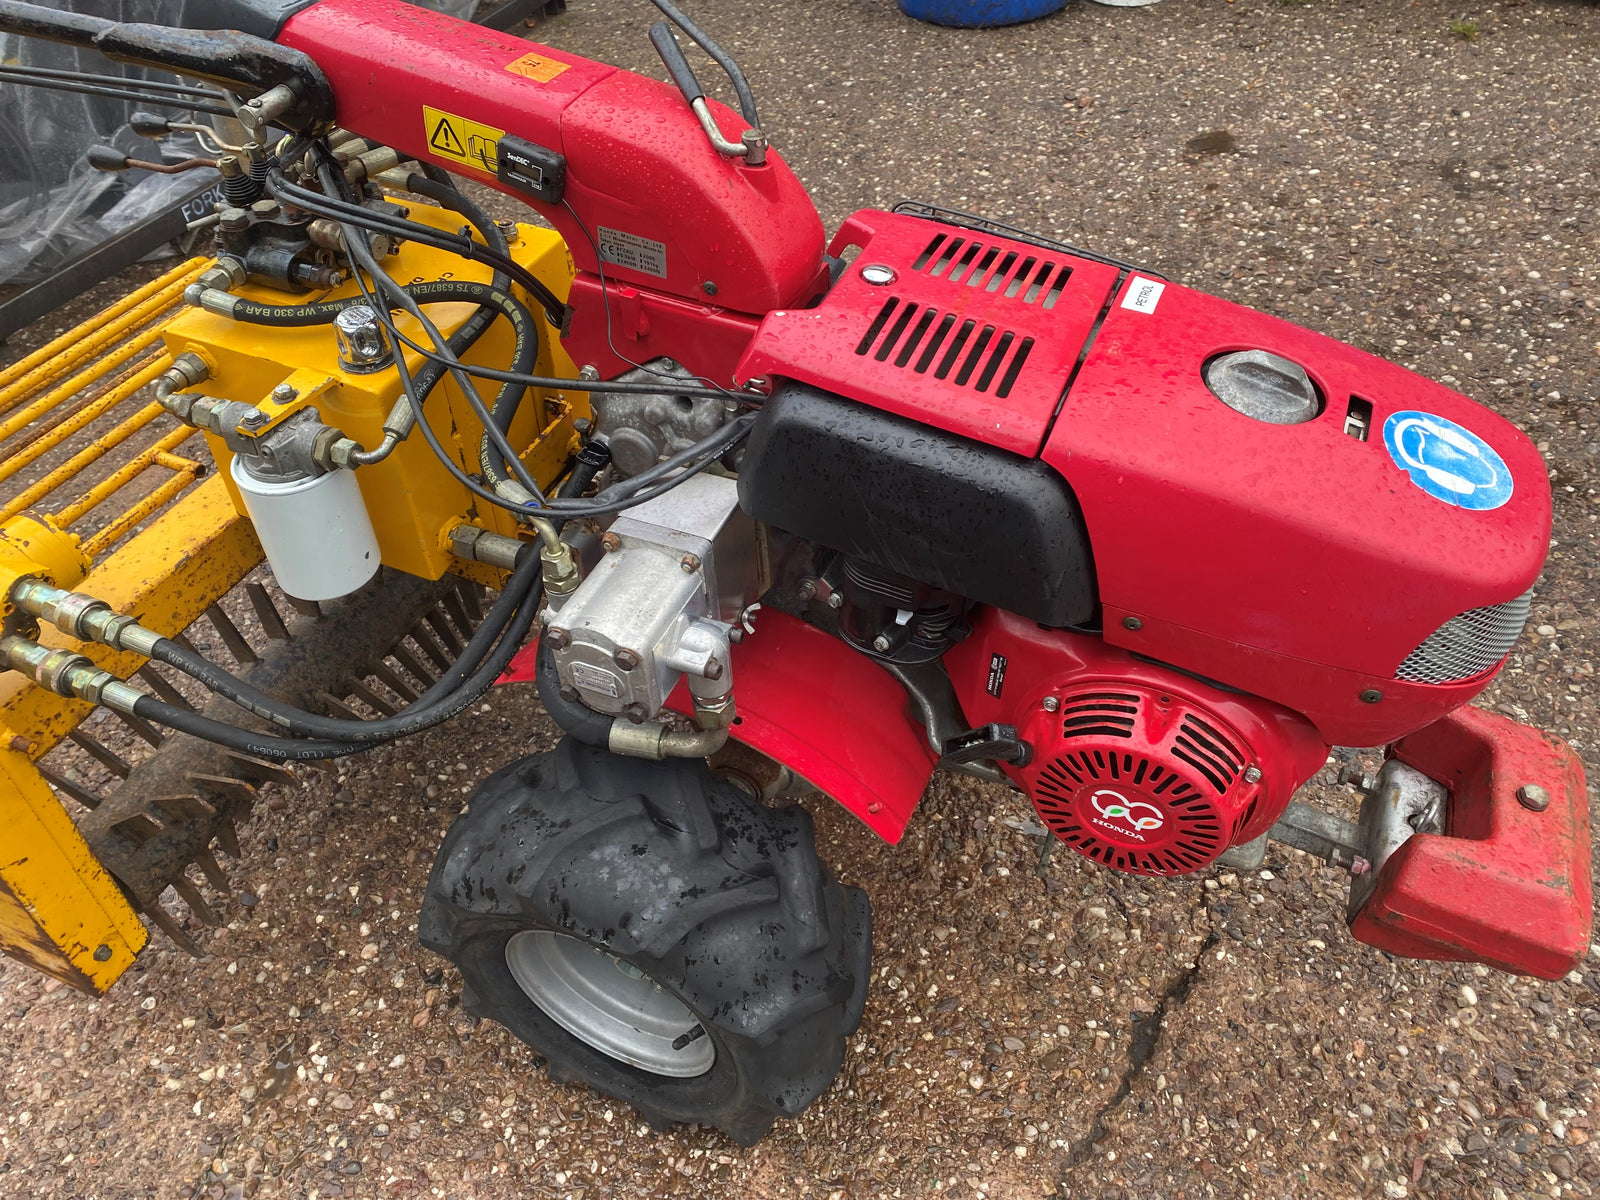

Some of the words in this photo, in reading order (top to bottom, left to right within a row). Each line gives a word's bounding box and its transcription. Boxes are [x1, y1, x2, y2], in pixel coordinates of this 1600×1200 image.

[181, 184, 225, 222] FORK
[600, 243, 614, 255] CE
[413, 284, 454, 296] 6387/EN
[456, 284, 469, 293] TS
[1135, 285, 1154, 307] PETROL
[245, 305, 271, 317] BAR
[274, 308, 294, 317] 330
[297, 307, 316, 317] WP
[318, 302, 344, 313] Max.
[1092, 817, 1146, 842] HONDA
